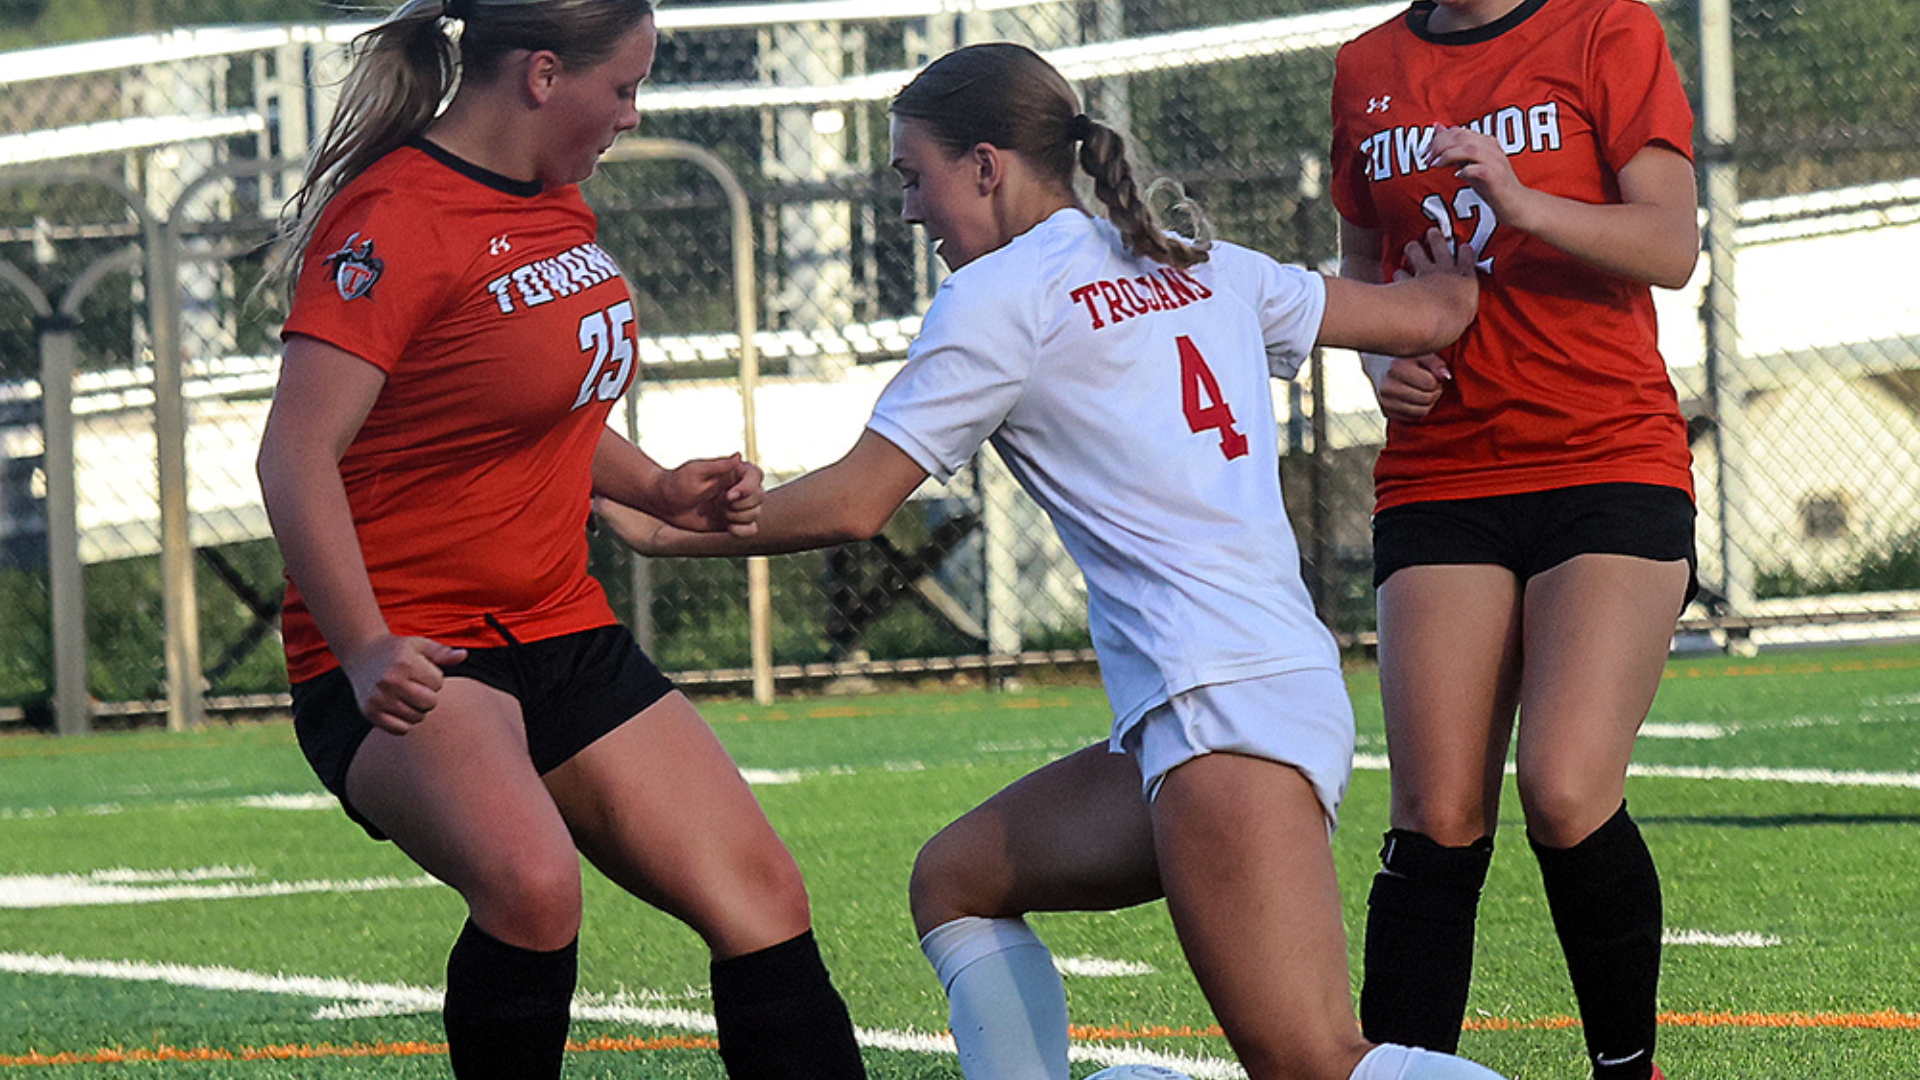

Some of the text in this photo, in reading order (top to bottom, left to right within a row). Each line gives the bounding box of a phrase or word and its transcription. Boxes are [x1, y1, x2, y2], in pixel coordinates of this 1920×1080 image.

[1359, 102, 1561, 181] TOWDA
[1421, 187, 1498, 274] 12
[1069, 266, 1213, 330] TROJANS
[570, 300, 635, 412] 25
[1175, 334, 1250, 462] 4
